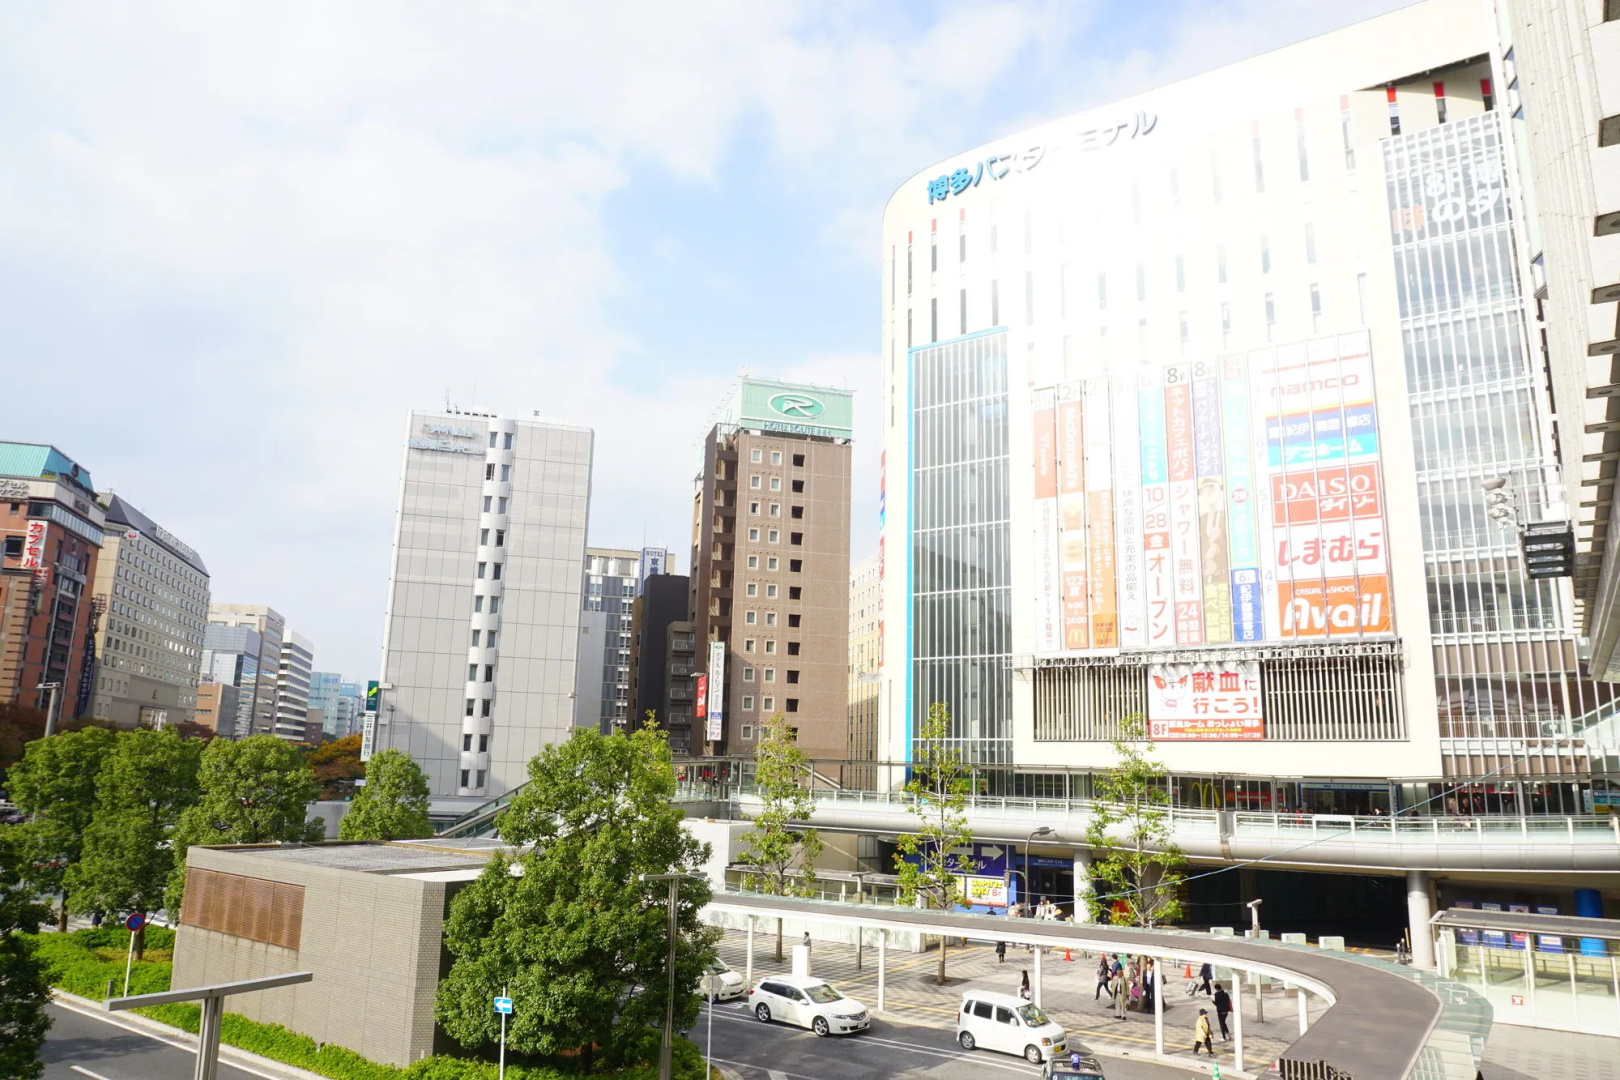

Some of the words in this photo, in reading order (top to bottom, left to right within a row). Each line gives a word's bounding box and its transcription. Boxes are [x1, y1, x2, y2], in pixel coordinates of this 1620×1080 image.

[1167, 367, 1186, 384] 8F
[1270, 373, 1360, 398] namco
[1280, 475, 1370, 500] DAISO
[1319, 495, 1375, 512] ダイソー
[23, 522, 44, 569] カプセル
[1149, 535, 1163, 548] 金
[1175, 485, 1194, 595] シャワー無料
[1277, 532, 1381, 567] しまむら
[1148, 553, 1168, 640] オープン
[1178, 604, 1198, 619] 24
[1283, 593, 1382, 631] Avail
[1192, 671, 1258, 694] 献血に
[1192, 696, 1259, 714] 行こう!
[1152, 723, 1167, 736] 8F
